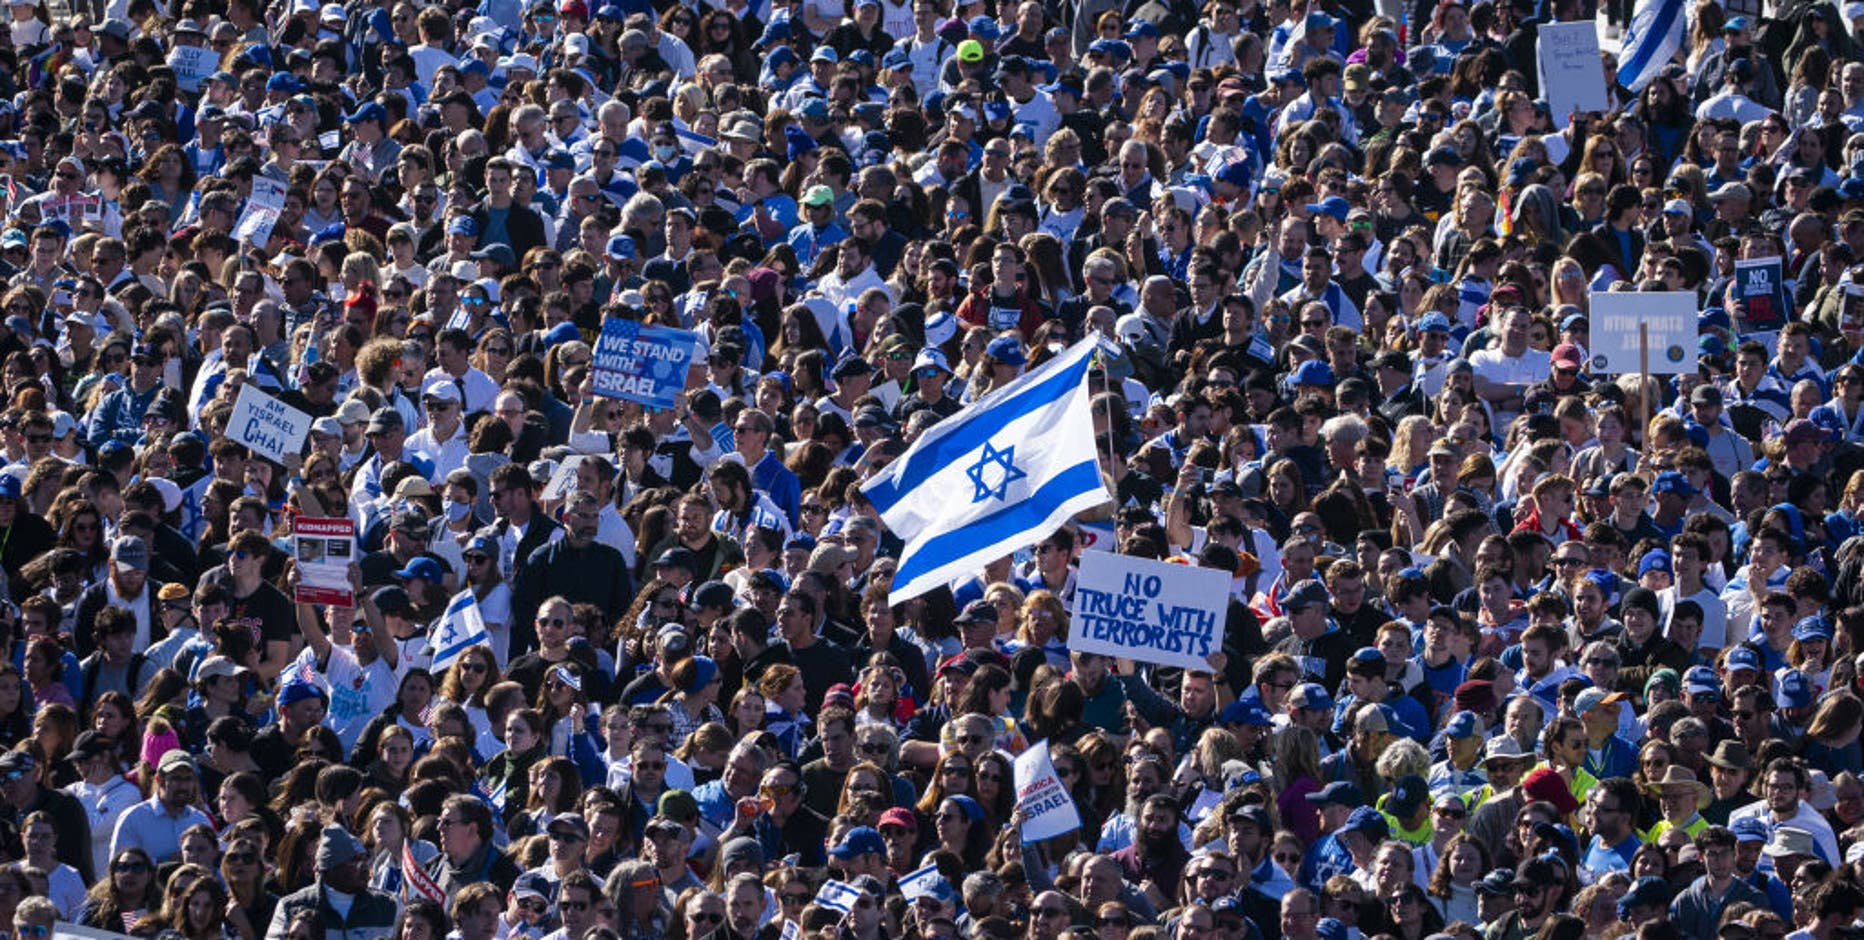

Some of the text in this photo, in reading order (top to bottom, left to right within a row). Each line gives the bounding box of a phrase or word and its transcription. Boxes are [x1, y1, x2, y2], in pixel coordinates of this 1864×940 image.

[1748, 269, 1768, 284] NO
[598, 353, 637, 371] WITH
[604, 335, 686, 363] WE STAND
[593, 370, 657, 398] ISRAEL
[247, 402, 295, 436] YISRAEL
[265, 399, 286, 416] AM
[243, 417, 284, 454] CHAI
[297, 523, 352, 534] KIDNAPPED
[1123, 571, 1162, 598] NO
[1077, 587, 1216, 634] TRUCE WITH
[1079, 613, 1213, 657] TERRORISTS
[1026, 791, 1069, 819] SRAEL
